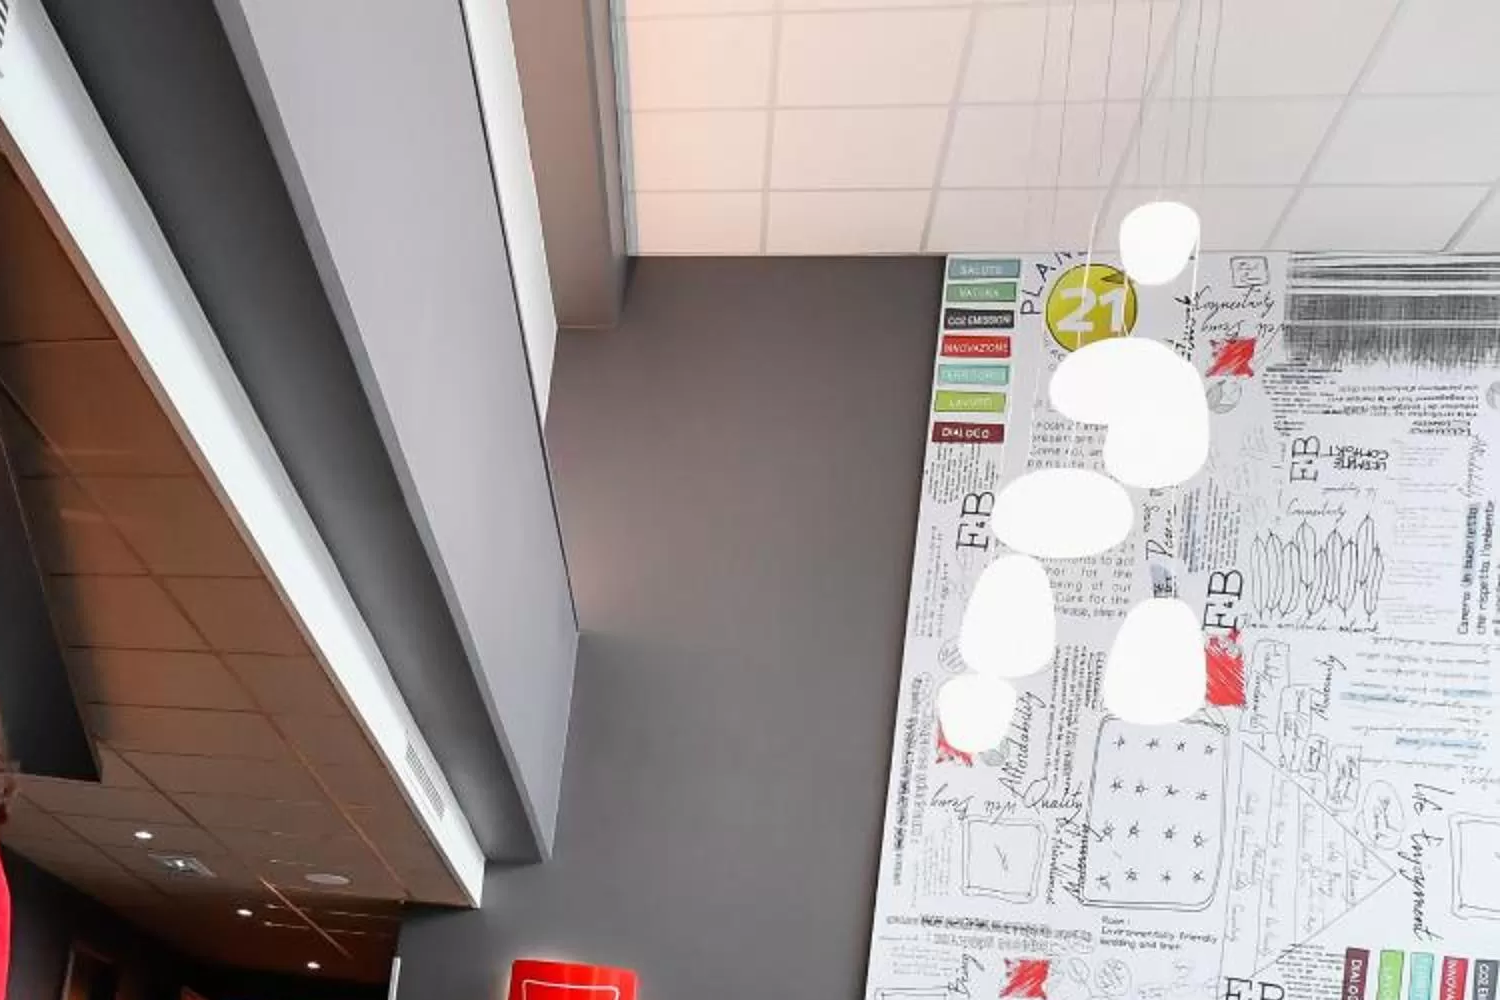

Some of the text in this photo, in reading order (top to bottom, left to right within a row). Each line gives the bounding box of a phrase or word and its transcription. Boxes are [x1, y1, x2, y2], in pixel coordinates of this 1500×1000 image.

[1056, 287, 1125, 333] 21
[941, 427, 990, 439] DIALOGO
[1477, 963, 1490, 986] CO2
